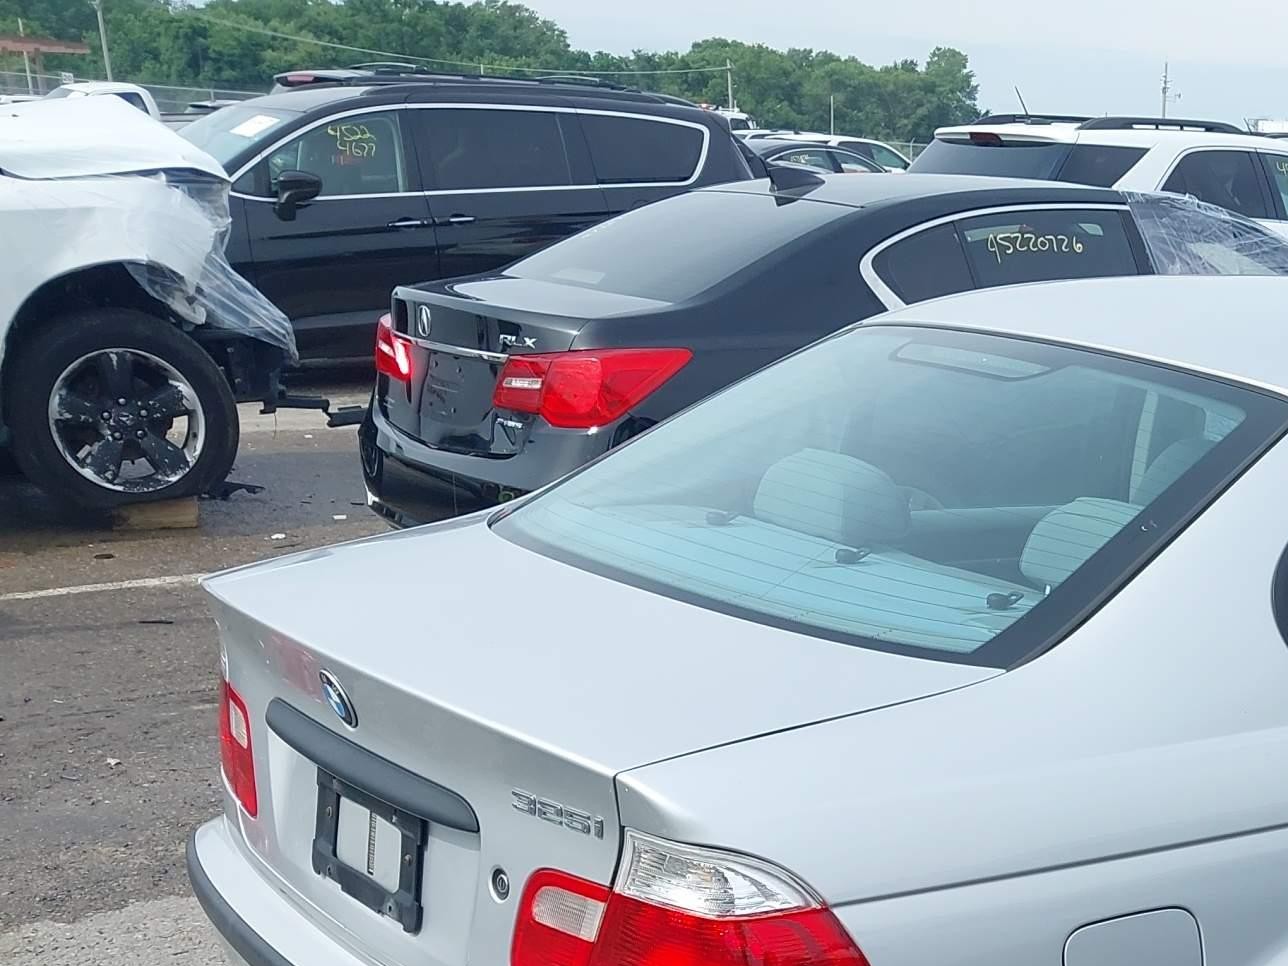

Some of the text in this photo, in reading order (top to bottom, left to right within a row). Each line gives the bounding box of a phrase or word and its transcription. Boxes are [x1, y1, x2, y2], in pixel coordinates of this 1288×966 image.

[328, 125, 376, 141] 4522
[337, 141, 375, 157] 4677
[499, 334, 537, 349] RLX
[511, 787, 604, 840] 325i
